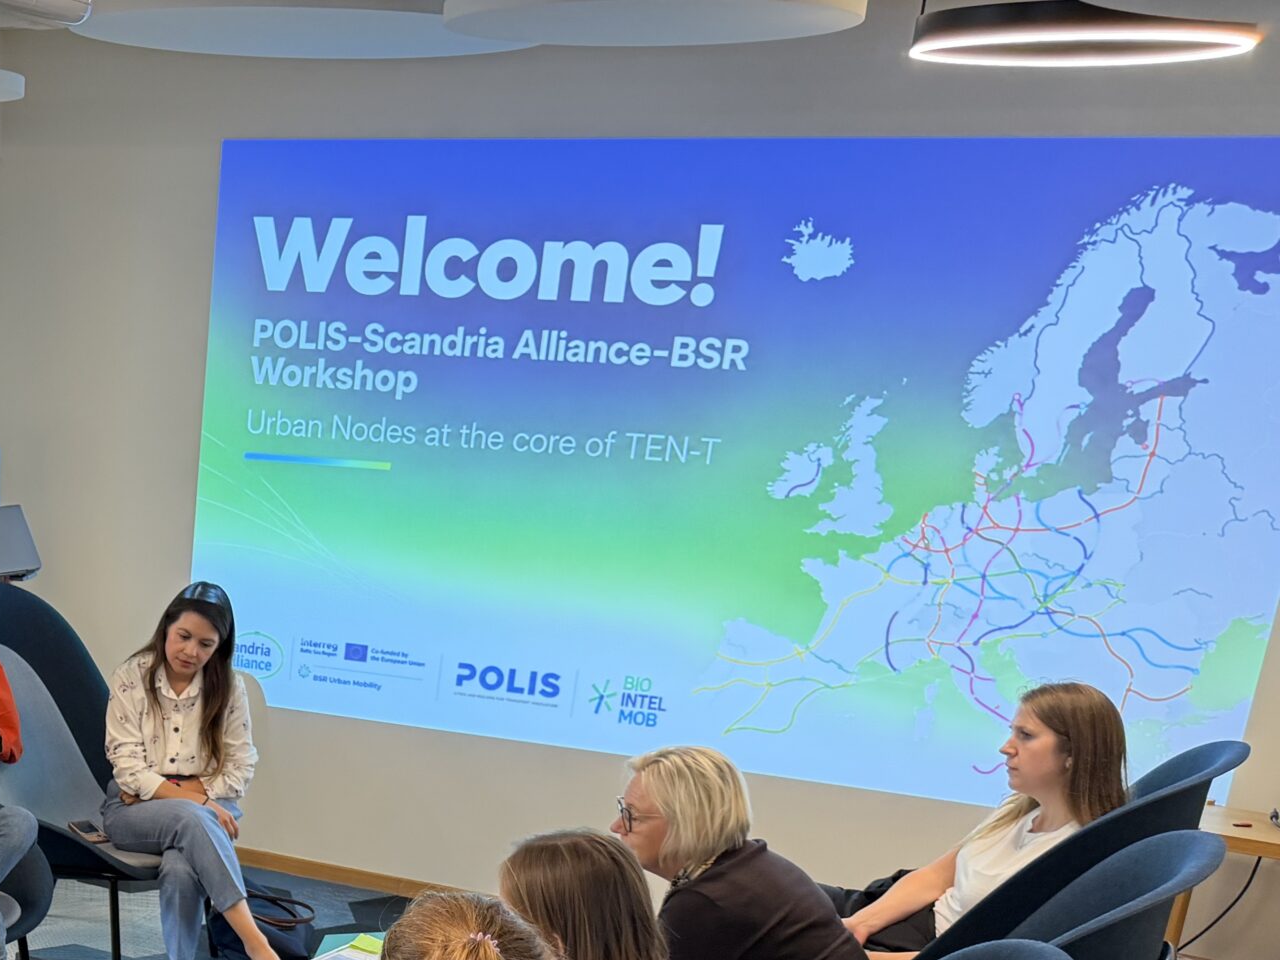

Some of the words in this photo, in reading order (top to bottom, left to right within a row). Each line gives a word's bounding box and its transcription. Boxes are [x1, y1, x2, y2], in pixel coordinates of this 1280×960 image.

[253, 215, 725, 307] Welcome!
[252, 318, 505, 360] POLIS-Scandria
[512, 329, 750, 370] Alliance-BSR
[250, 355, 418, 400] Workshop
[246, 409, 323, 439] Urban
[332, 415, 416, 446] Nodes
[423, 421, 451, 448] at
[460, 422, 504, 450] the
[512, 429, 576, 457] core
[585, 430, 616, 458] of
[625, 431, 722, 465] TEN-T
[233, 654, 272, 672] lliance
[329, 677, 351, 685] Urban
[352, 680, 382, 691] Mobility
[455, 662, 561, 698] POLIS
[623, 676, 652, 692] BIO
[621, 692, 667, 712] INTEL
[618, 709, 658, 728] MOB
